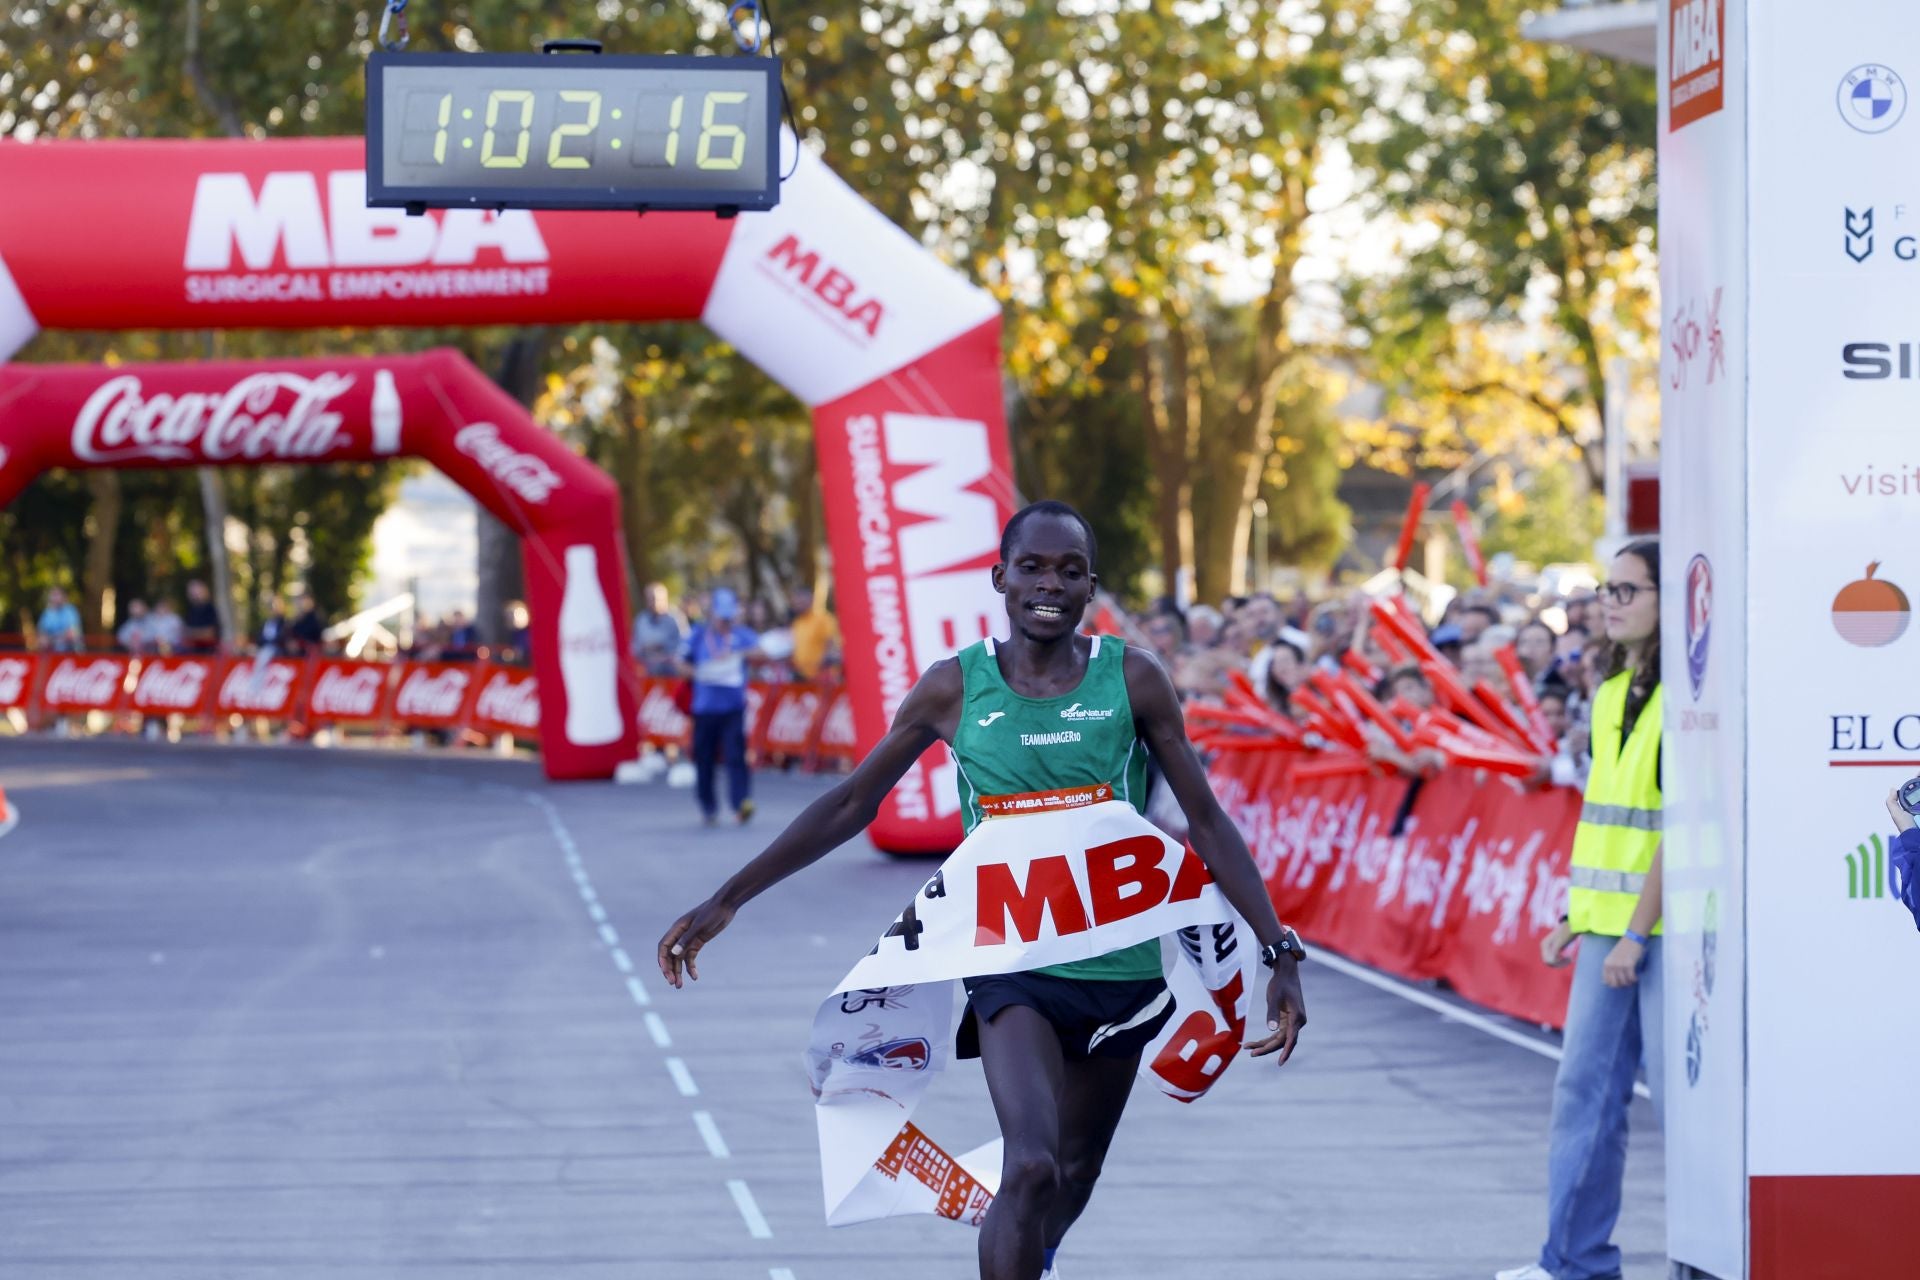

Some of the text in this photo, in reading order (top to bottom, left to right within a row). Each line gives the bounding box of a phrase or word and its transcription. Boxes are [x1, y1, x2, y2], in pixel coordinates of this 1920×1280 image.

[433, 90, 749, 170] 1:02:16
[184, 169, 549, 270] MBA
[186, 268, 549, 302] SURGICAL EMPOWERMENT
[768, 235, 884, 338] MBA
[1843, 342, 1920, 379] SI
[846, 414, 893, 572] SURGICAL
[1830, 715, 1883, 750] EL
[1016, 798, 1043, 808] MBA
[1065, 792, 1092, 804] GIJÓN
